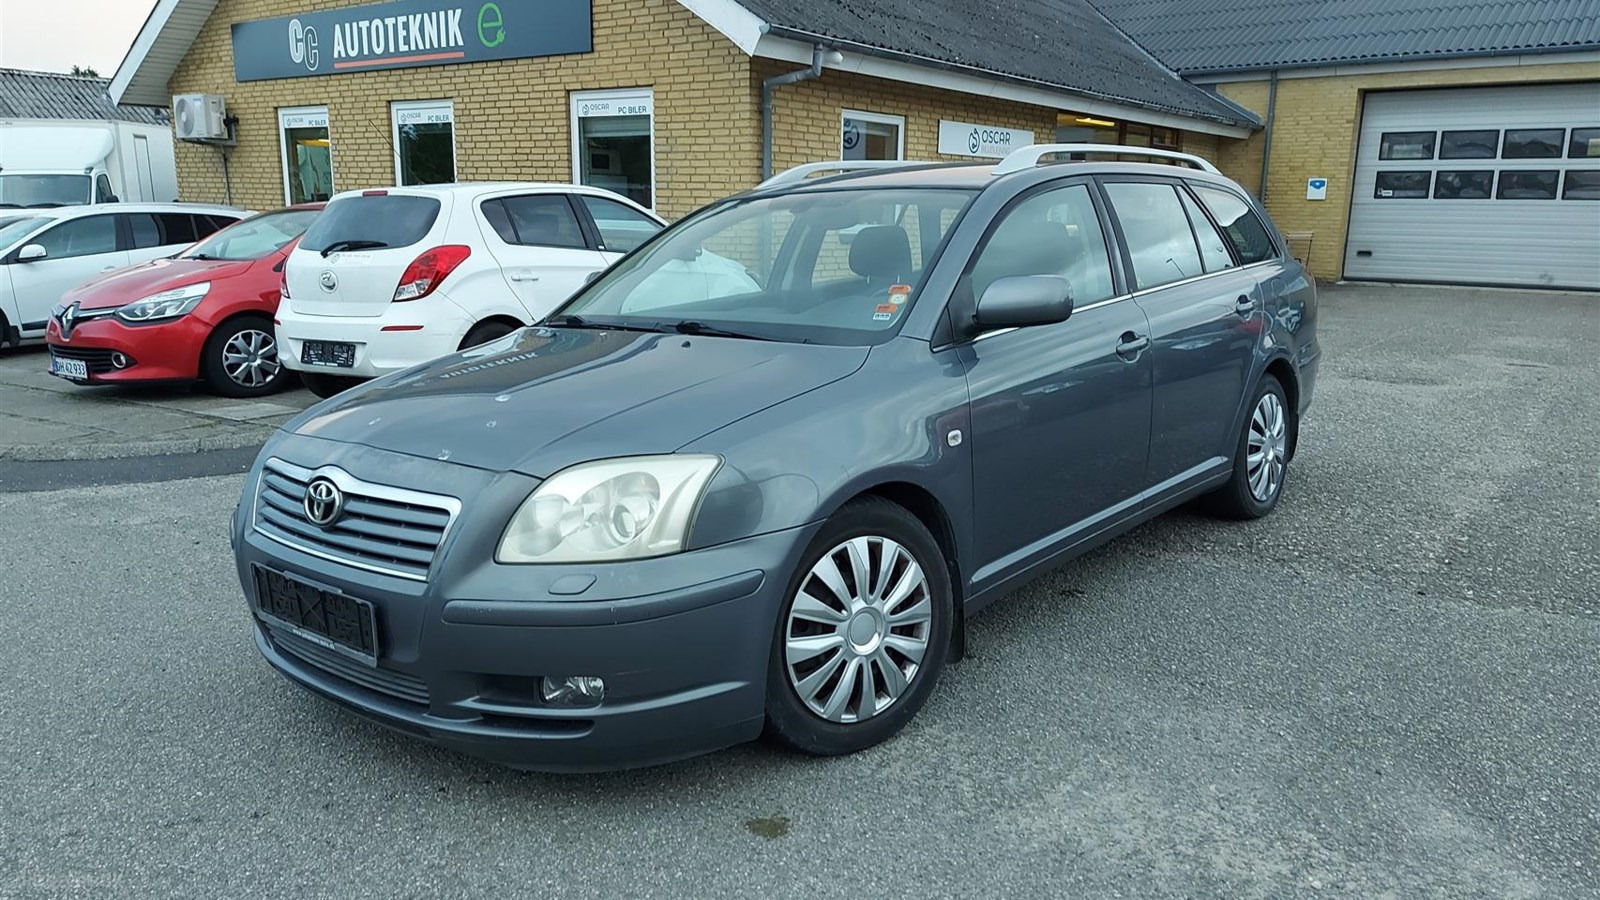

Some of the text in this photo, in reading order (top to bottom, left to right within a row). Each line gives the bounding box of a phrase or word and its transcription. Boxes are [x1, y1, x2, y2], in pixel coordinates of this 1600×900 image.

[333, 9, 464, 58] AUTOTEKNIK
[590, 103, 610, 111] OSCAR
[982, 130, 1011, 145] OSCAR
